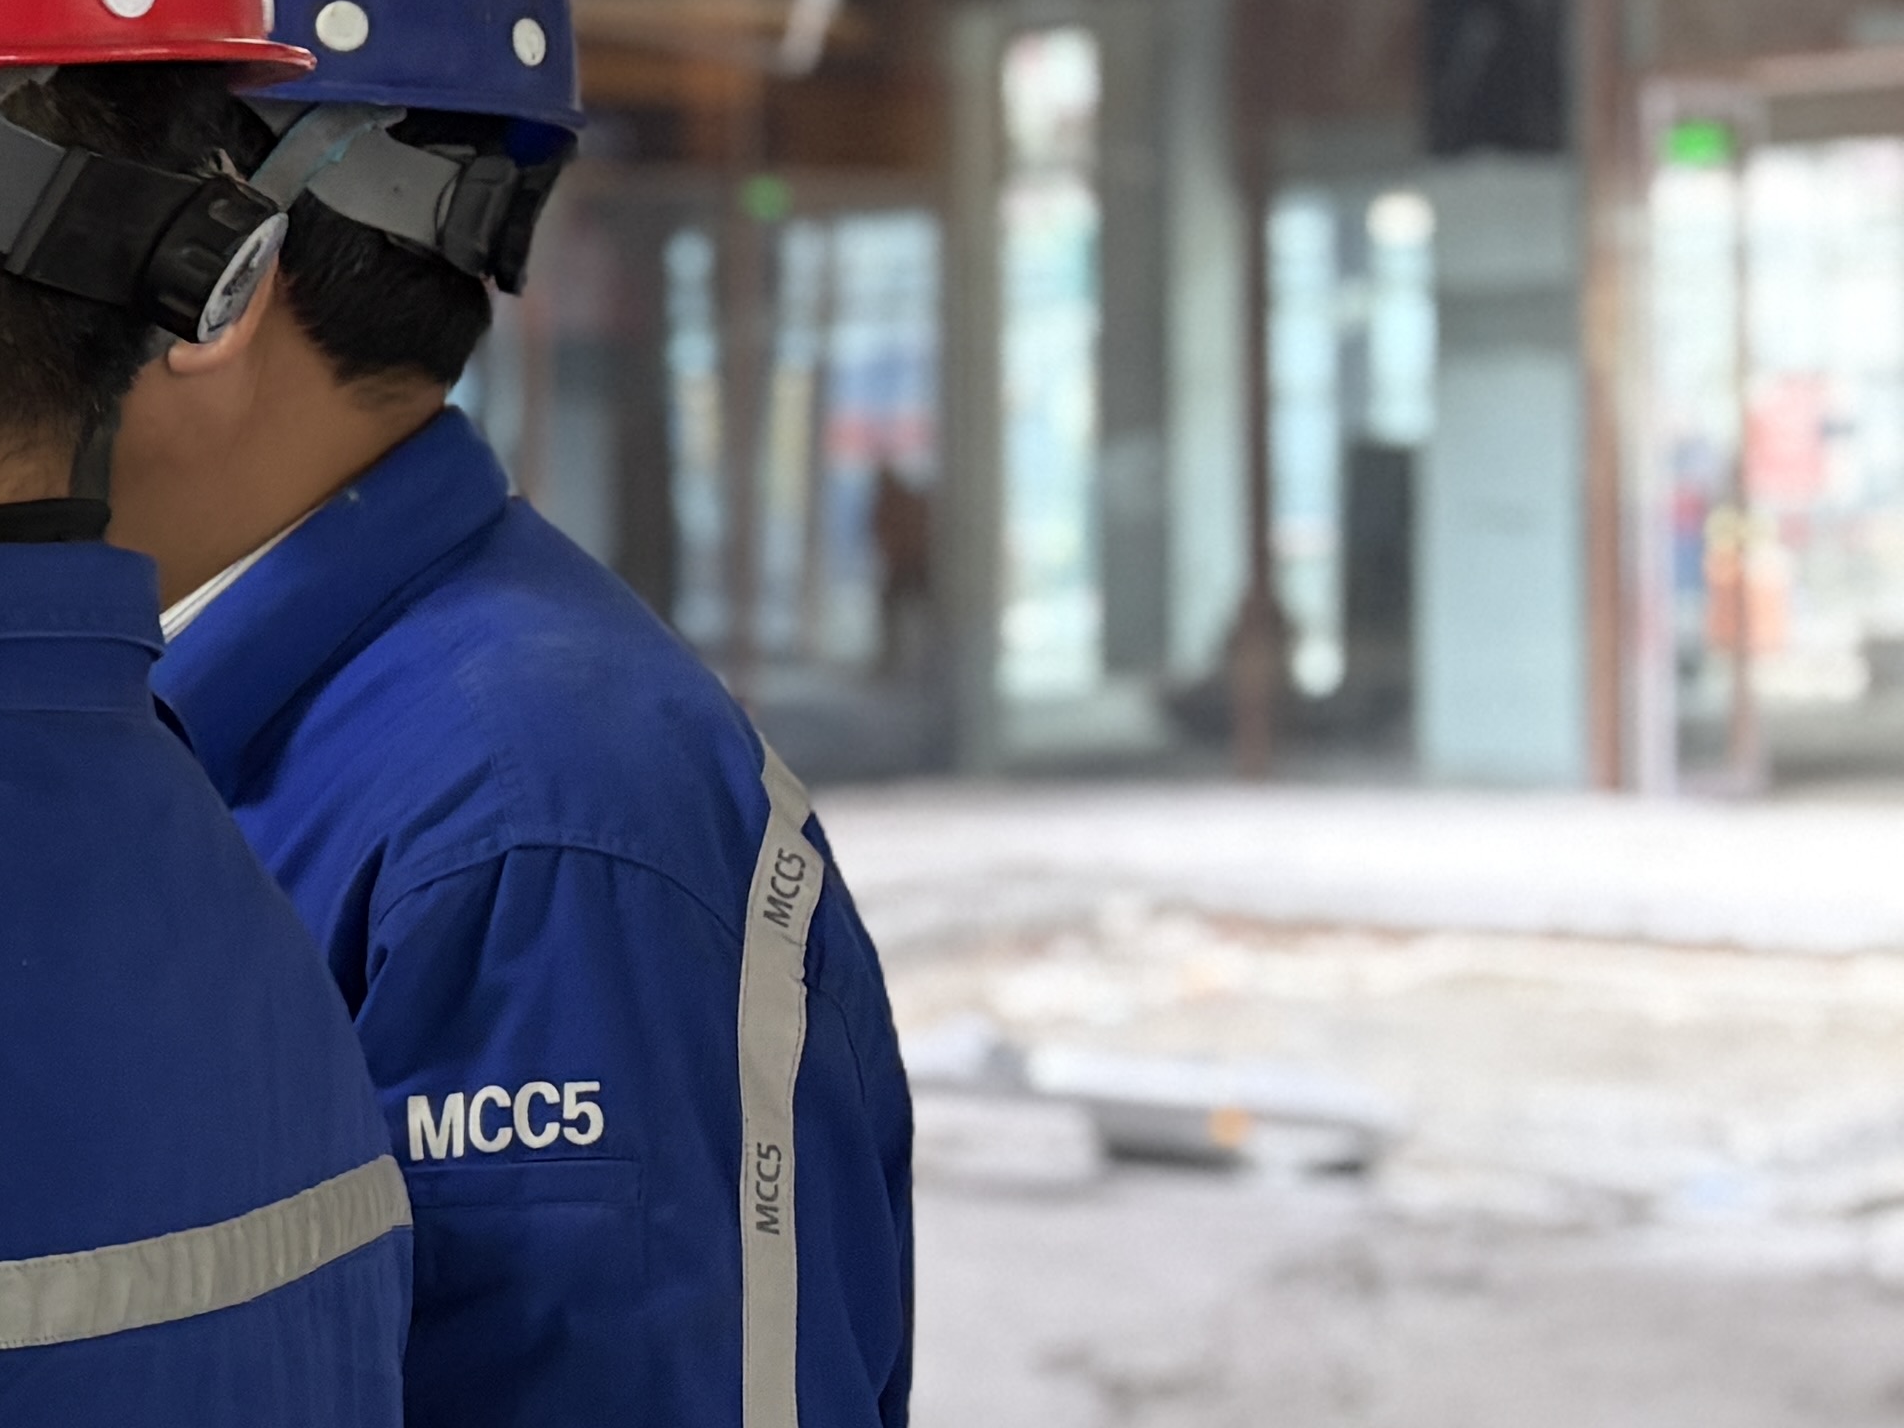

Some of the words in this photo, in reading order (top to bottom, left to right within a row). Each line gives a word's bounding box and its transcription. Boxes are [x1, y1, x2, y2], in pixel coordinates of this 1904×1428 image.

[762, 847, 807, 929] MCC5
[406, 1080, 605, 1162] MCC5
[755, 1141, 782, 1236] MCC5
